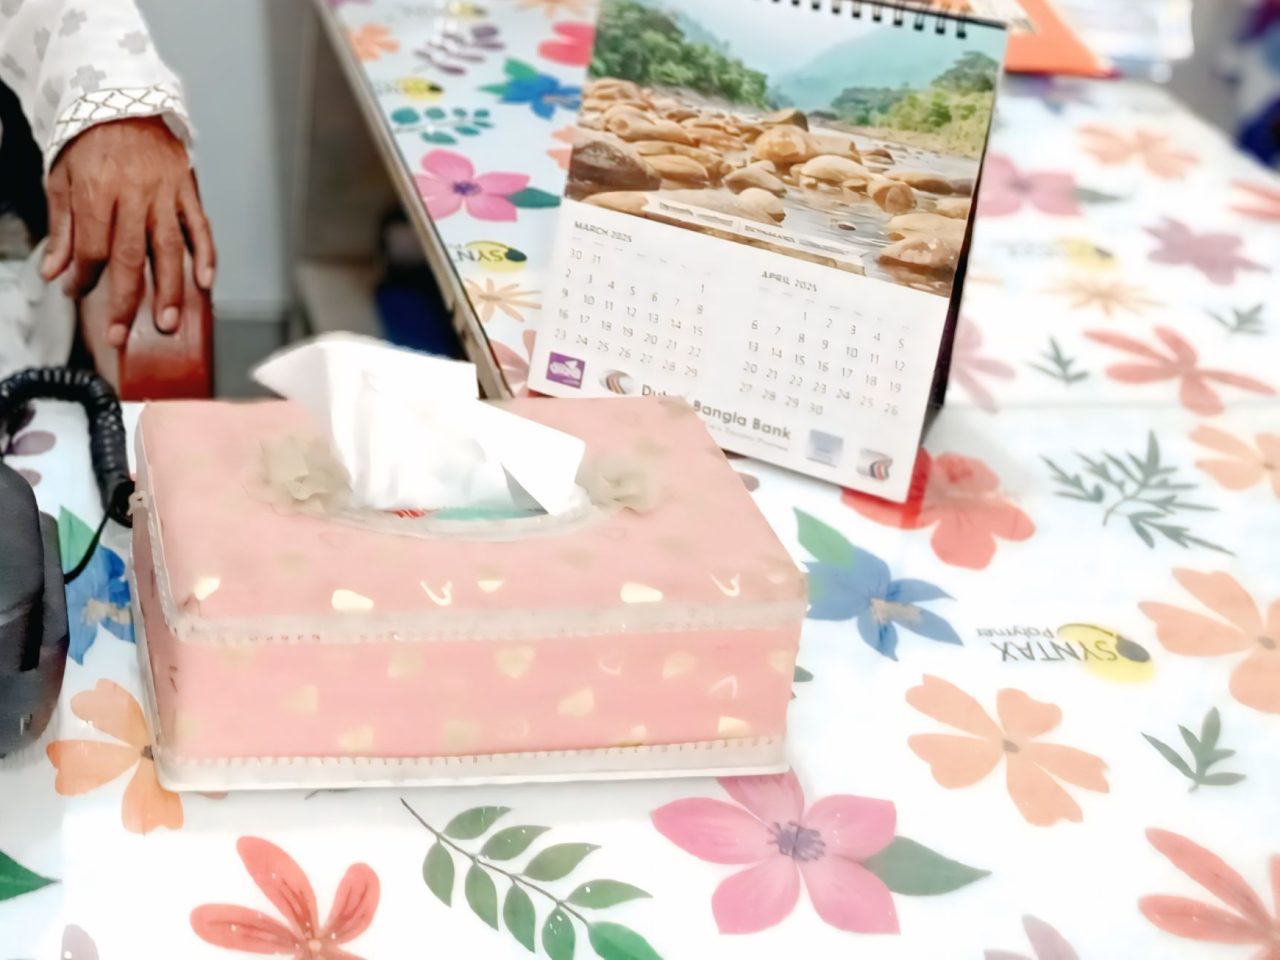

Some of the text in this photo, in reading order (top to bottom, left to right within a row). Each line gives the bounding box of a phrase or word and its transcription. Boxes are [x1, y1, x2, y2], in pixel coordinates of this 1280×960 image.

[575, 221, 609, 237] MARCH
[762, 270, 790, 286] APRIL
[693, 399, 747, 428] Bangla
[752, 415, 793, 440] Bank
[976, 626, 1054, 639] Polymer
[990, 640, 1118, 662] SYNTAX
